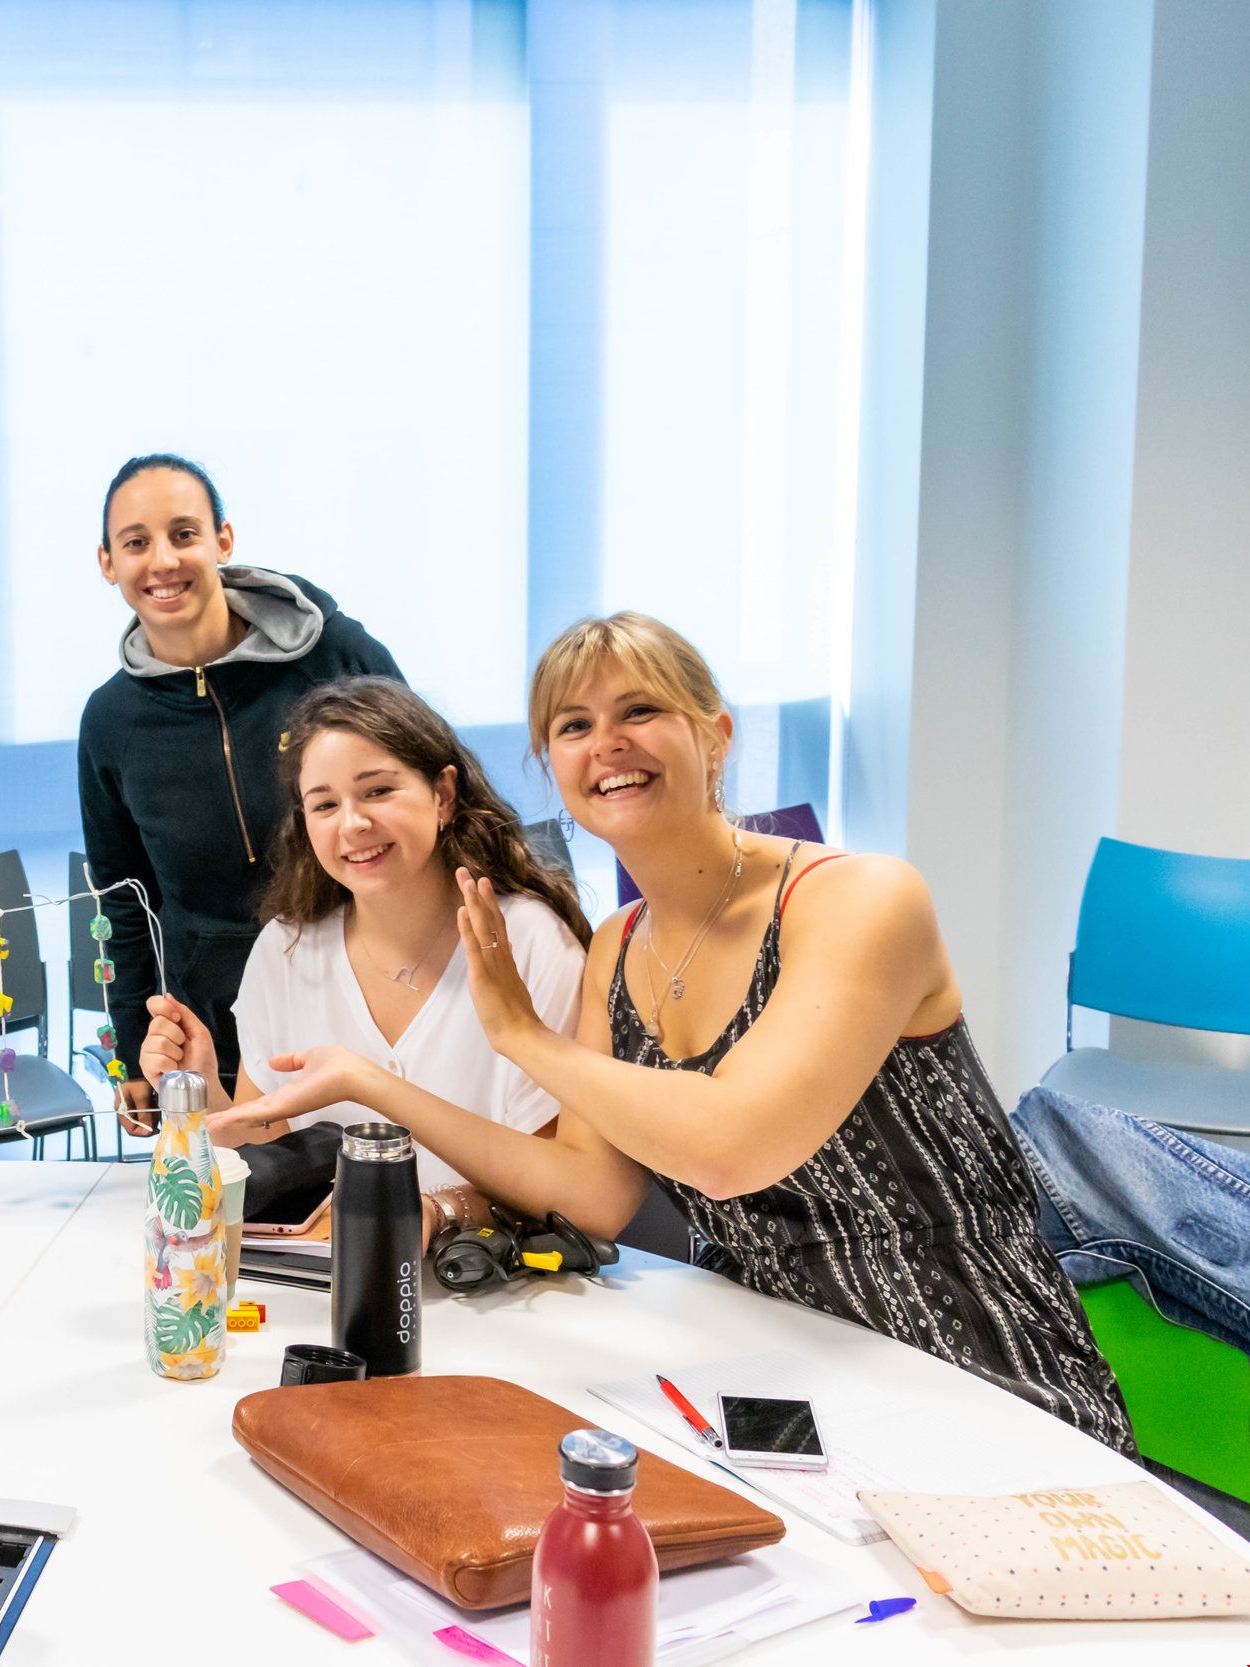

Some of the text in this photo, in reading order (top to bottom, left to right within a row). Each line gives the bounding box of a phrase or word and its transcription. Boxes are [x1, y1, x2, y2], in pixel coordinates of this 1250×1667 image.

[396, 1262, 412, 1343] doppio
[1012, 1491, 1104, 1508] YOUR
[1039, 1511, 1126, 1529] OWN
[1050, 1534, 1162, 1561] MAGIC
